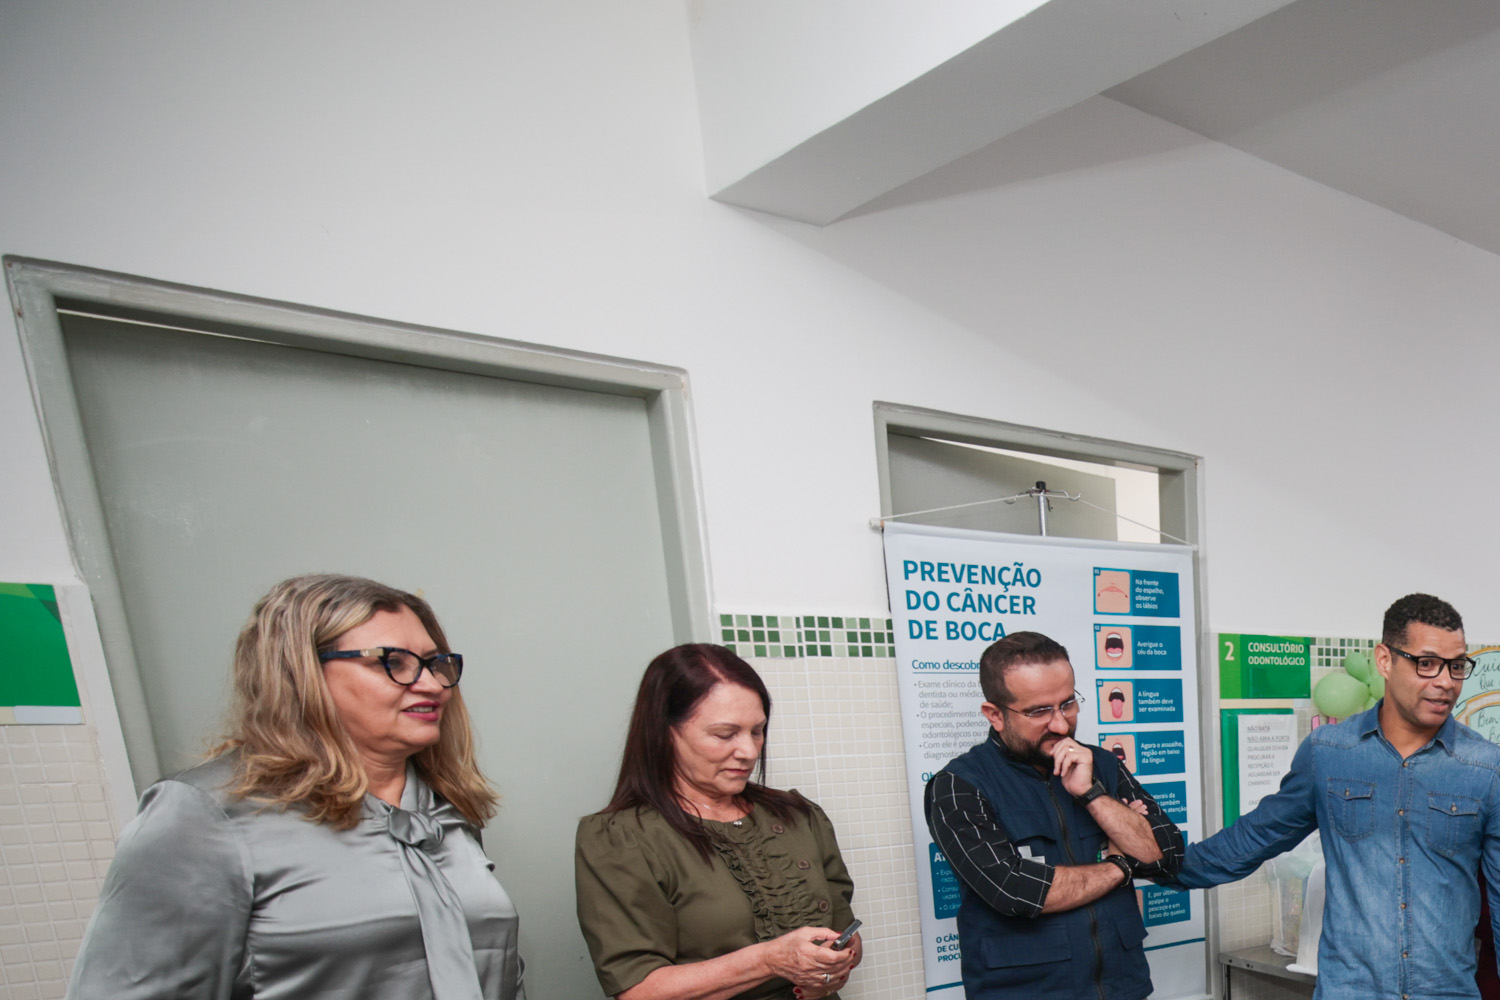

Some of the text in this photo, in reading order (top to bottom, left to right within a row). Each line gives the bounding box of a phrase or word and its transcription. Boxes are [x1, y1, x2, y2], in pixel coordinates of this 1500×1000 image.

[903, 560, 1042, 592] PREVENÇÃO
[905, 588, 1036, 615] DO CÂNCER
[908, 619, 1007, 641] DE BOCA
[1137, 641, 1158, 649] Averigue
[1248, 642, 1304, 653] CONSULTÓRIO
[1225, 641, 1234, 661] 2
[912, 659, 940, 669] Como
[1248, 655, 1305, 665] ODONTOLÓGICO
[943, 680, 966, 688] clínico
[919, 690, 947, 698] dentista
[1143, 690, 1159, 698] língua
[920, 711, 926, 719] O
[929, 710, 976, 719] procedimento
[956, 720, 988, 729] podendo
[922, 730, 971, 740] odontológicos
[923, 741, 940, 749] Com
[942, 740, 952, 748] ele
[1141, 742, 1156, 750] Agora
[1141, 749, 1157, 757] região
[936, 936, 942, 944] O
[937, 945, 947, 953] DE
